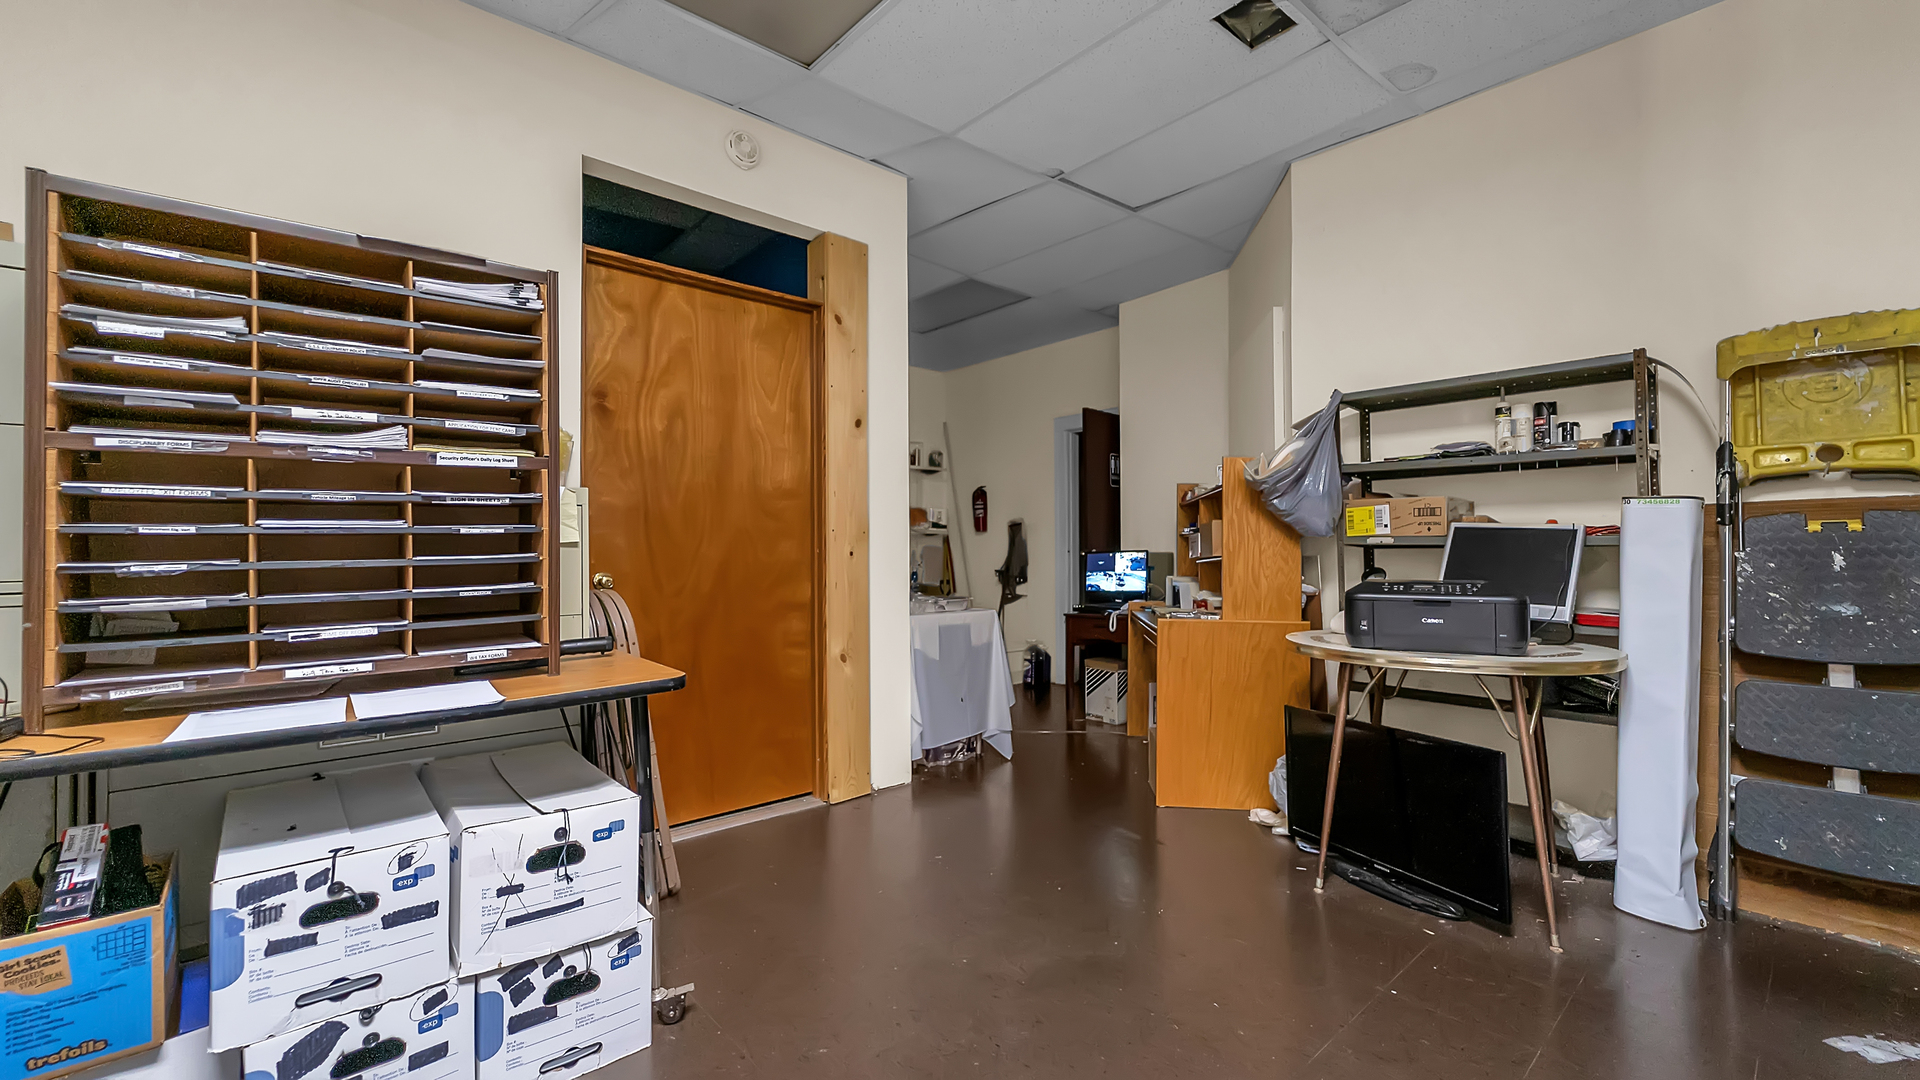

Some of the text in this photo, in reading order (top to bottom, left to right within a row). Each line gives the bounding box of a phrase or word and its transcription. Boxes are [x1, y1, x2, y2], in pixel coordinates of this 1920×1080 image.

[118, 439, 165, 447] DISCIPLANARY
[130, 686, 153, 695] COVER
[155, 683, 180, 691] SHEETS
[24, 950, 61, 966] Scout
[19, 979, 38, 990] STAY
[26, 1039, 108, 1071] trefoils
